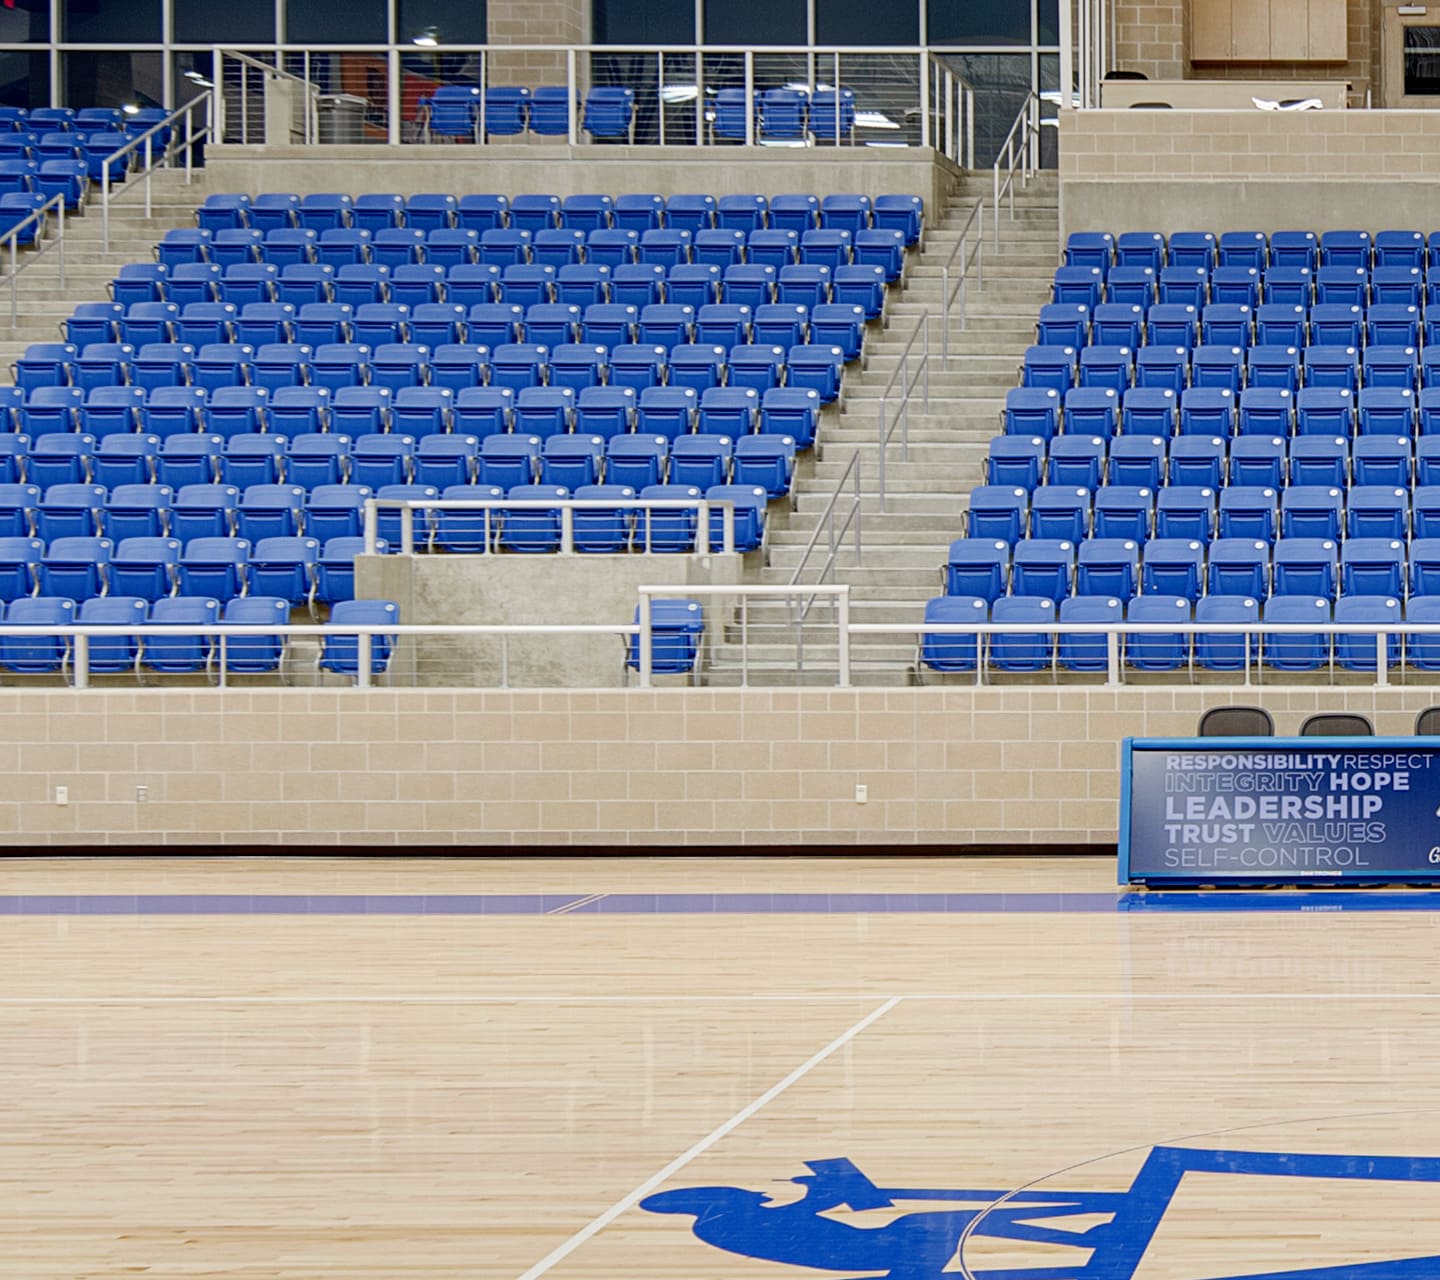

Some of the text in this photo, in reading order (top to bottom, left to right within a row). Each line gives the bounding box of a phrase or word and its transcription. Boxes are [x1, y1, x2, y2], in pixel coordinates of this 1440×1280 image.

[1166, 753, 1433, 770] RESPONSIBILITY RESPECT
[1165, 772, 1409, 792] INTEGRITY HOPE
[1166, 795, 1383, 820] LEADERSHIP
[1164, 822, 1386, 843] TRUST VALUES
[1164, 847, 1369, 867] SELF-CONTROL
